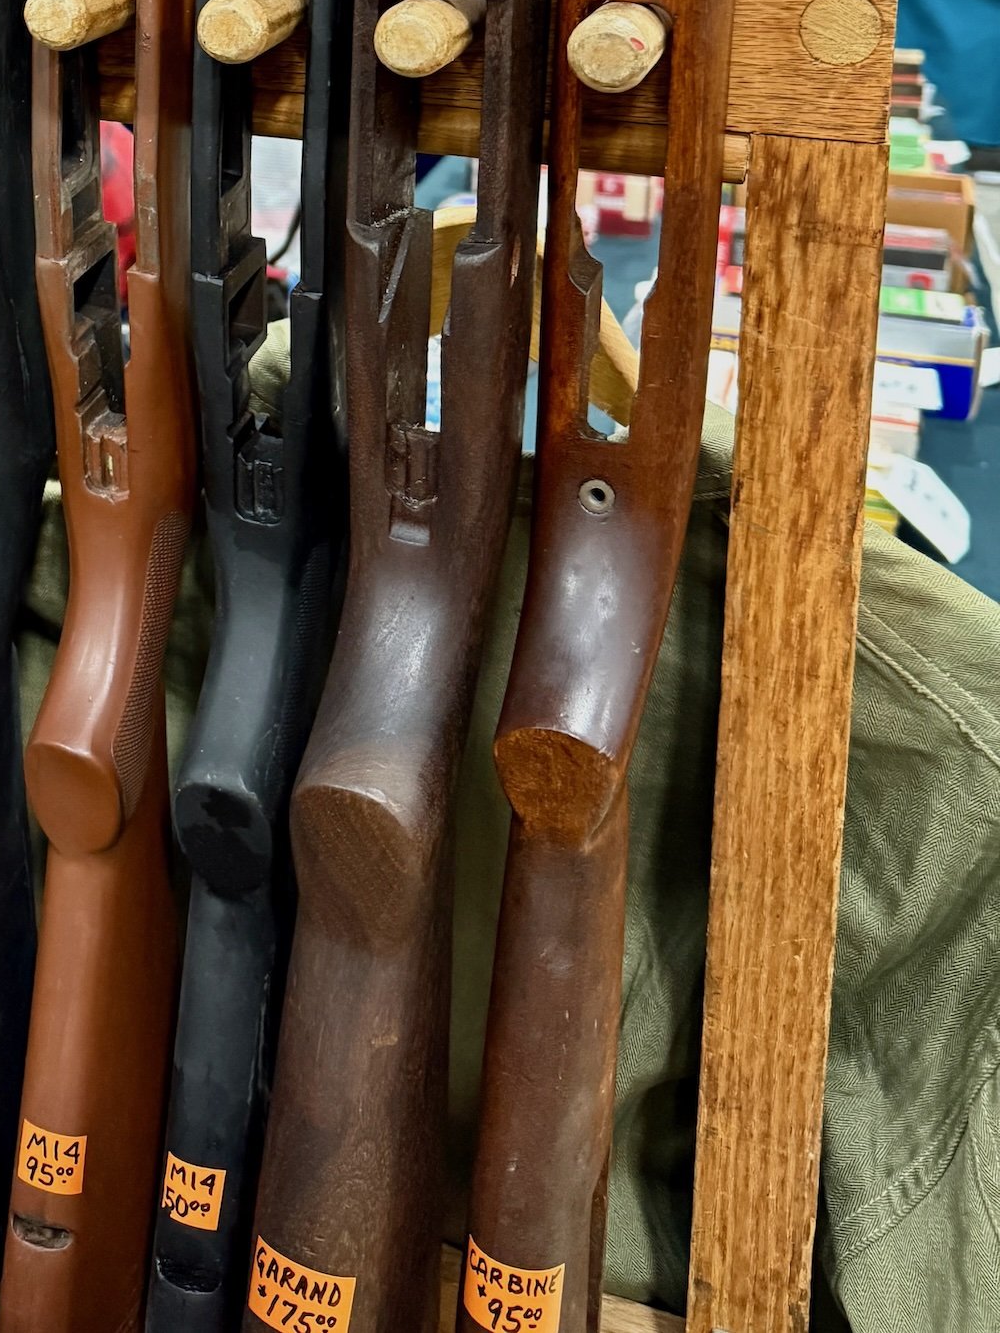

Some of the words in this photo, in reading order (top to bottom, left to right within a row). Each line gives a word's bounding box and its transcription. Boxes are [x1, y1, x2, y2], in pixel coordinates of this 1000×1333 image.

[26, 1133, 80, 1165] M14
[170, 1163, 216, 1196] M14
[256, 1246, 342, 1308] GARAND
[469, 1248, 562, 1297] CARBINE
